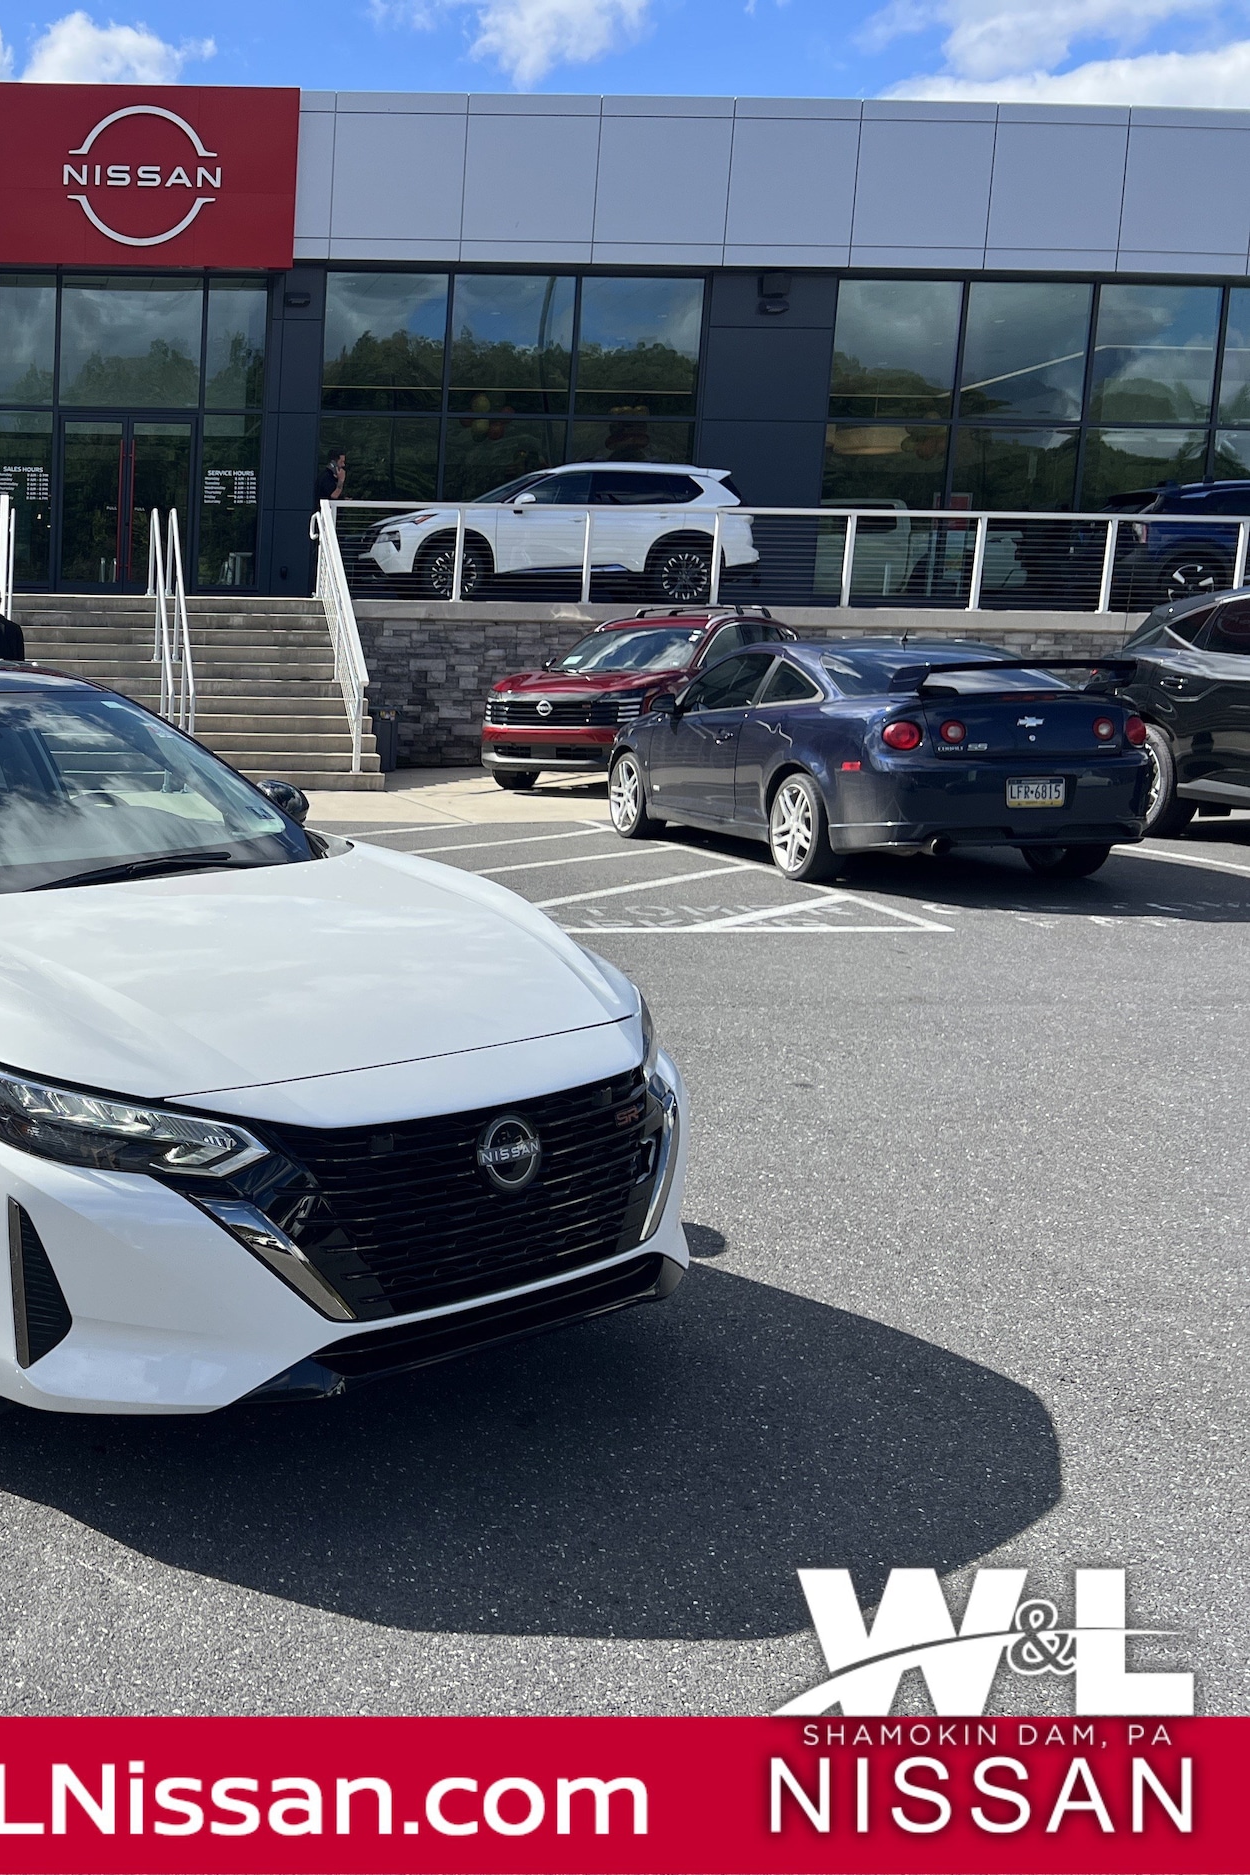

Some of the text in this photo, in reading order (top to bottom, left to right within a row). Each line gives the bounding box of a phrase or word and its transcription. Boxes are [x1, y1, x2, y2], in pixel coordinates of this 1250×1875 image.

[63, 164, 222, 188] NISSAN
[967, 743, 988, 751] SS
[616, 1106, 640, 1127] SR
[482, 1141, 541, 1164] NISSAN
